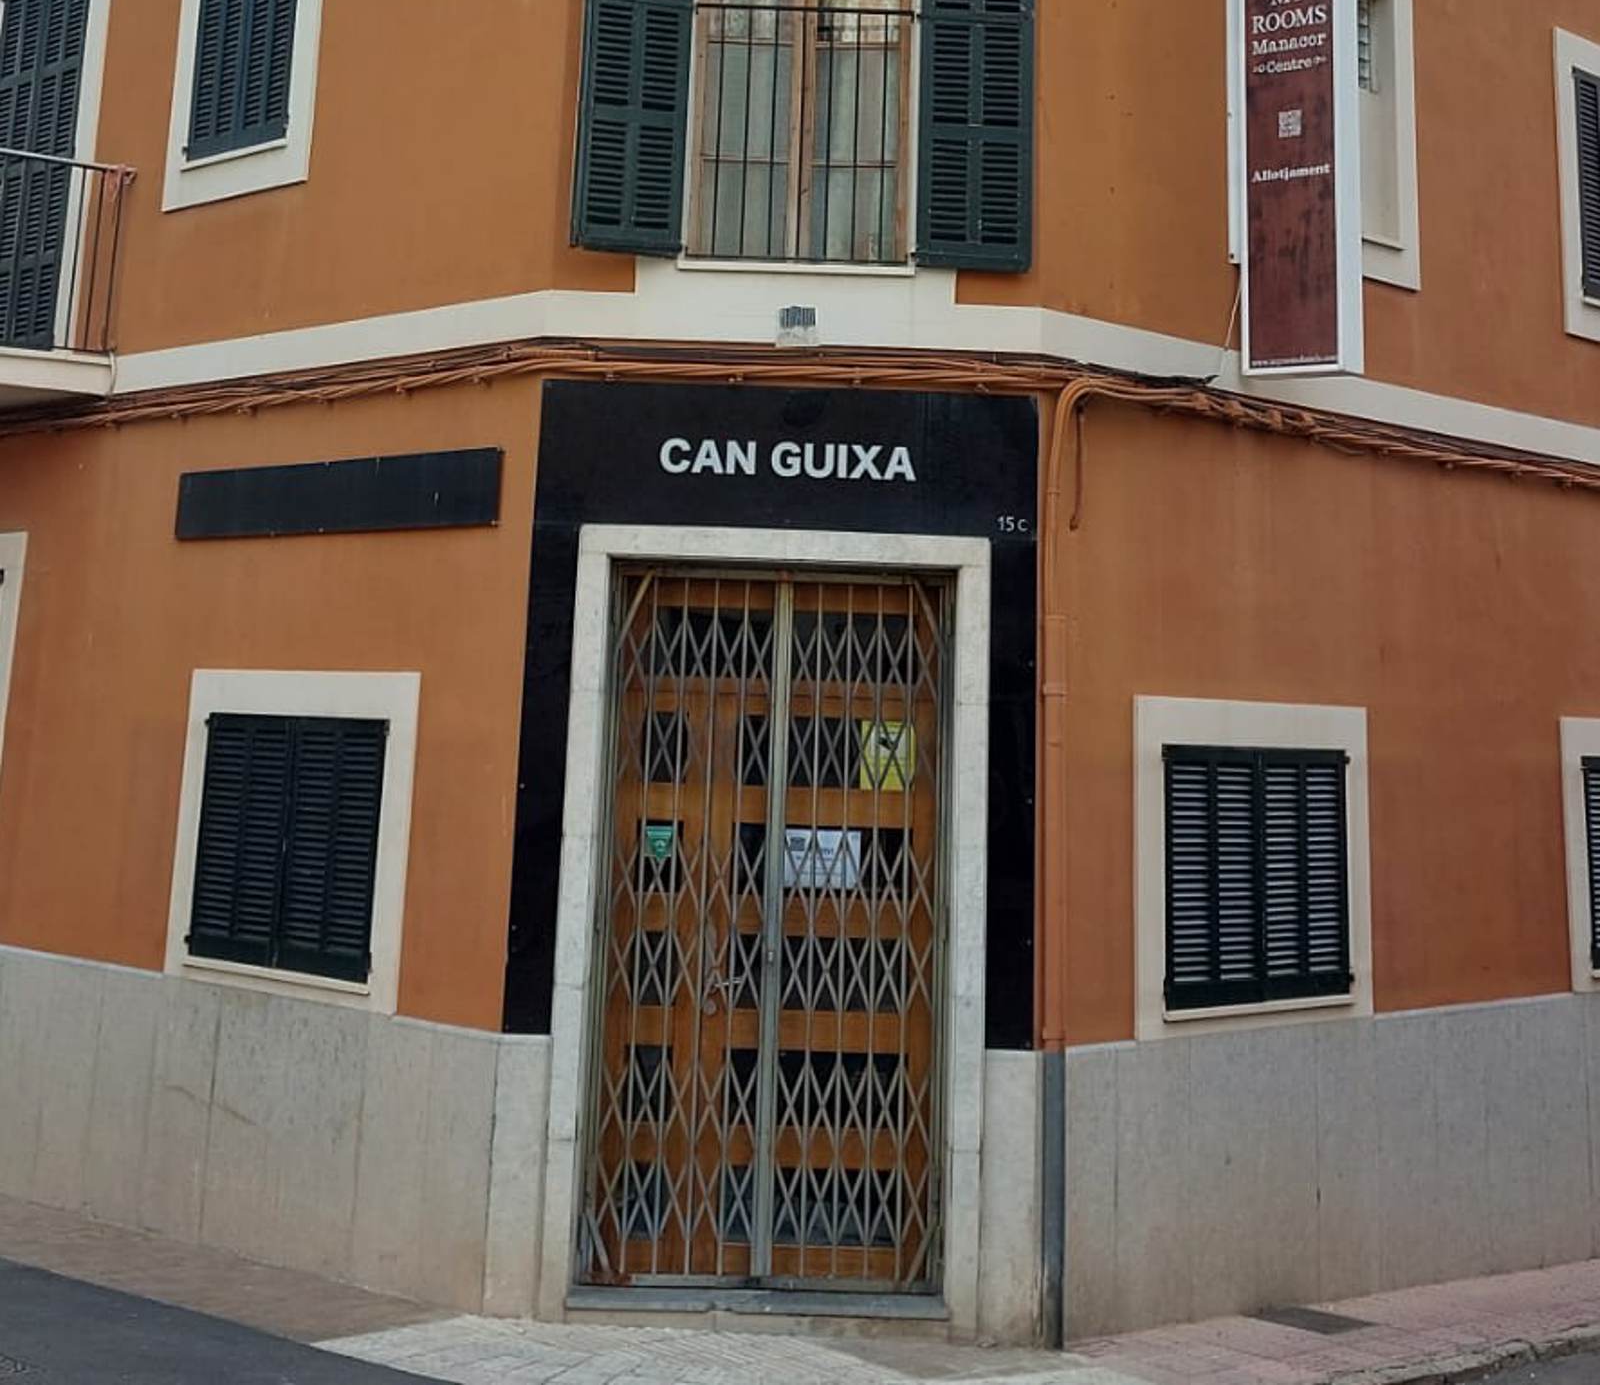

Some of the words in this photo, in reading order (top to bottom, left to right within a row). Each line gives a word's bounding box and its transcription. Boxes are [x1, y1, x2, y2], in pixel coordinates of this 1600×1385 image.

[1251, 4, 1328, 34] ROOMS
[1251, 33, 1328, 56] Manacor
[1266, 57, 1313, 73] Centre
[1251, 163, 1331, 183] Allotjament
[659, 437, 757, 476] CAN
[771, 440, 917, 482] GUIXA
